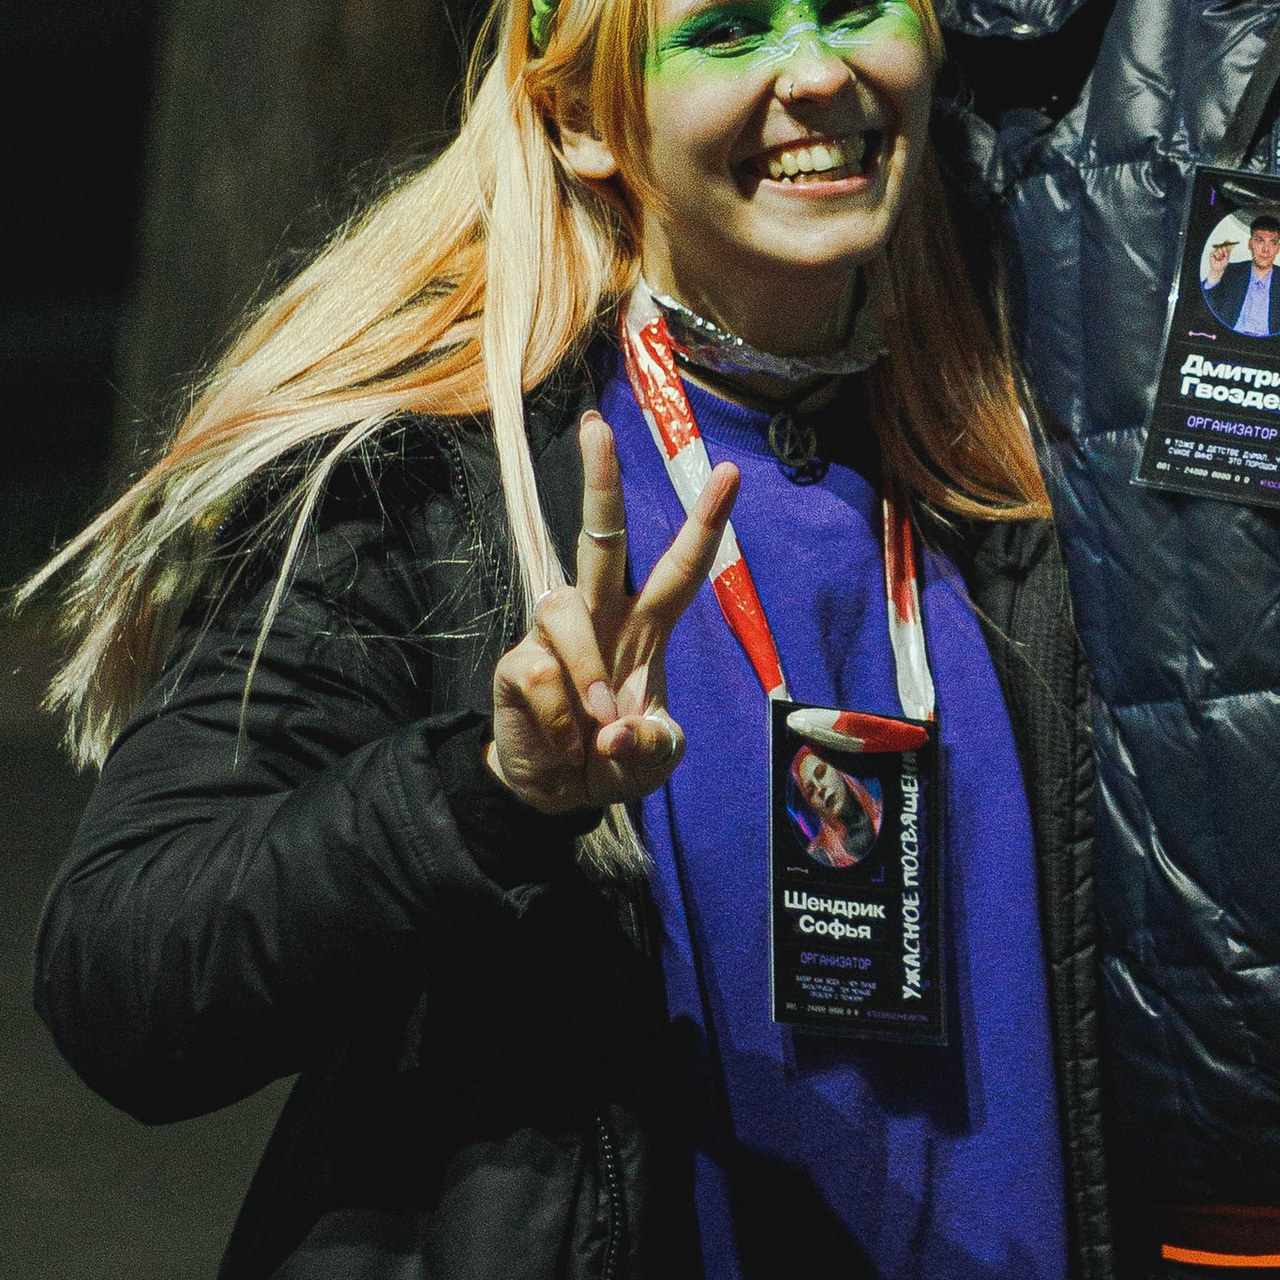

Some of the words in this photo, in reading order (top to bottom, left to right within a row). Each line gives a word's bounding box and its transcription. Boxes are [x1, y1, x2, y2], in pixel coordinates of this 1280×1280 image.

[1187, 415, 1279, 440] ОРГАНИЗАТОР
[1206, 445, 1240, 457] ДЕТСТВЕ
[1228, 456, 1242, 466] ЭТО
[784, 890, 886, 919] Шендрик
[799, 915, 872, 941] Софья
[901, 892, 922, 1002] УЖАСНОЕ
[800, 951, 872, 970] ОРГАНИЗАТОР
